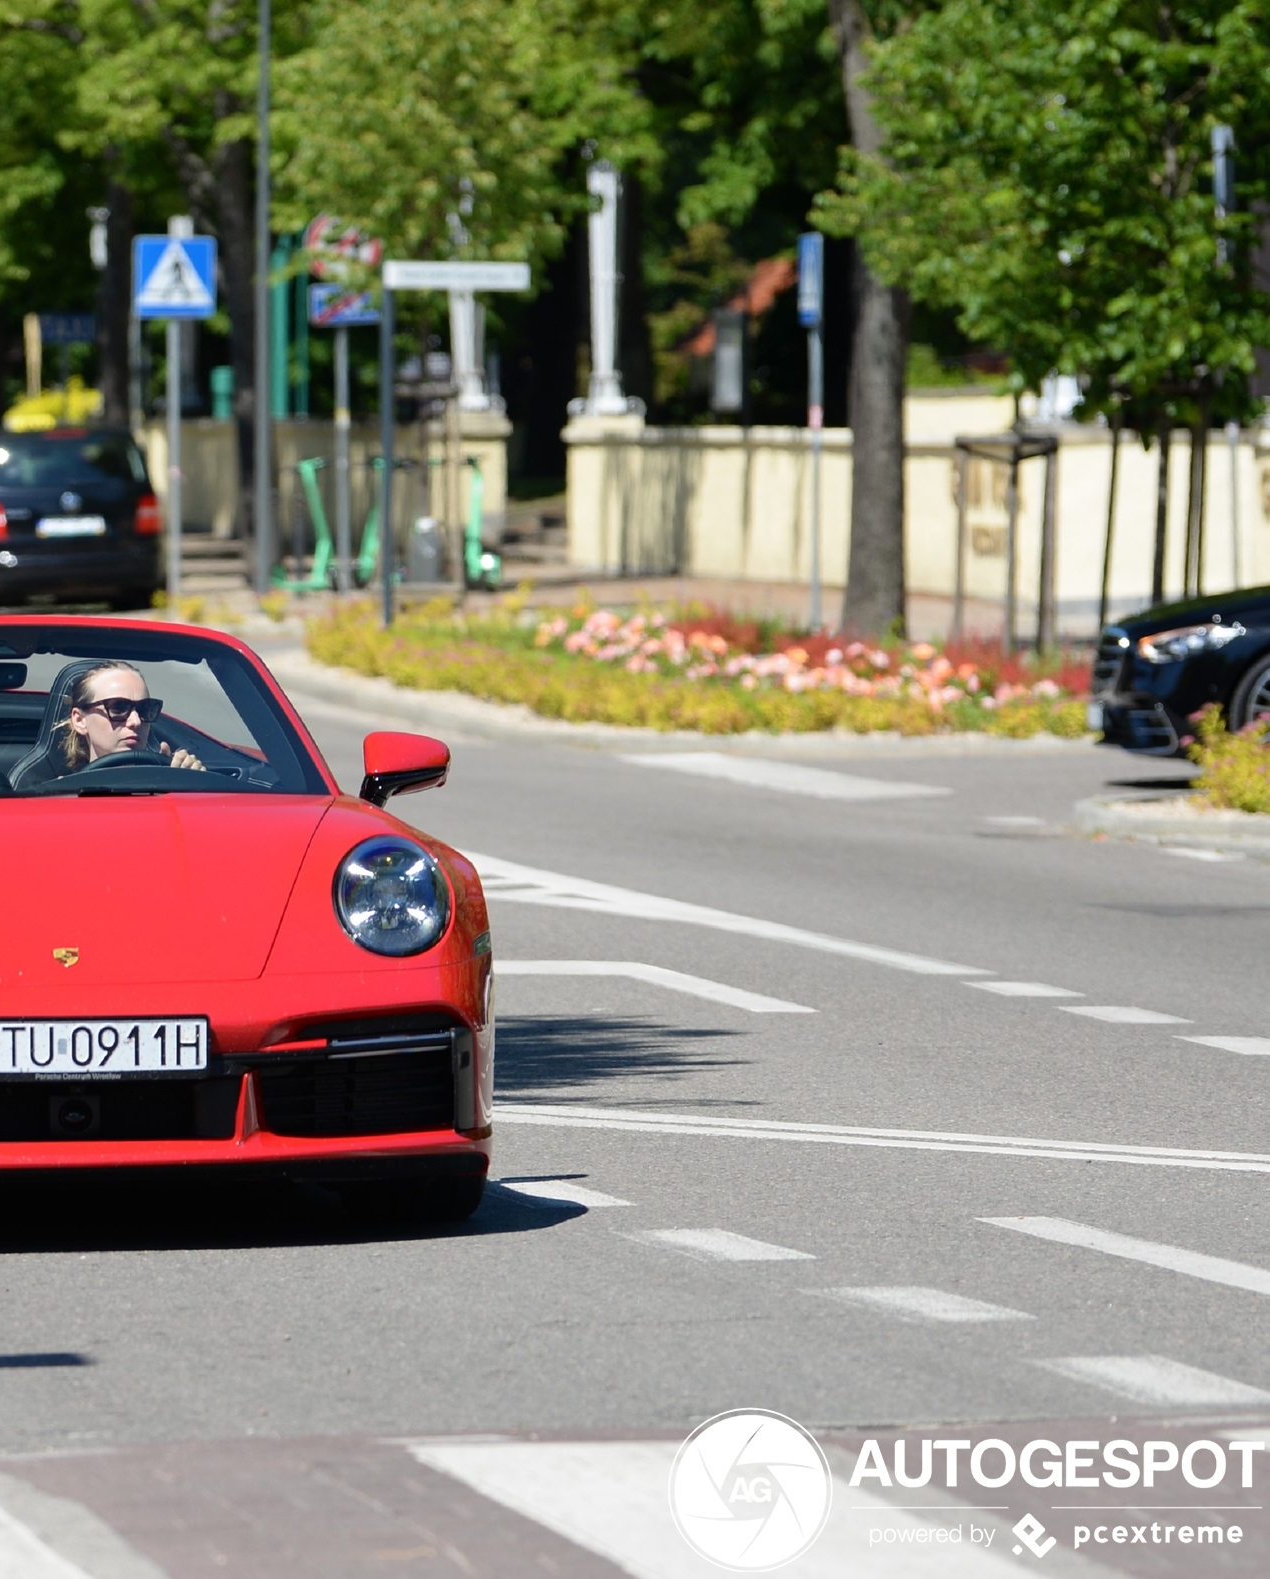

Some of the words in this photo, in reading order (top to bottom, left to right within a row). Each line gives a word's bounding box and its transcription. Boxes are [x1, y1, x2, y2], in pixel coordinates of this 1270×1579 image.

[70, 1024, 201, 1067] 0911H
[34, 1073, 62, 1081] Porsche
[62, 1073, 91, 1081] Centrum
